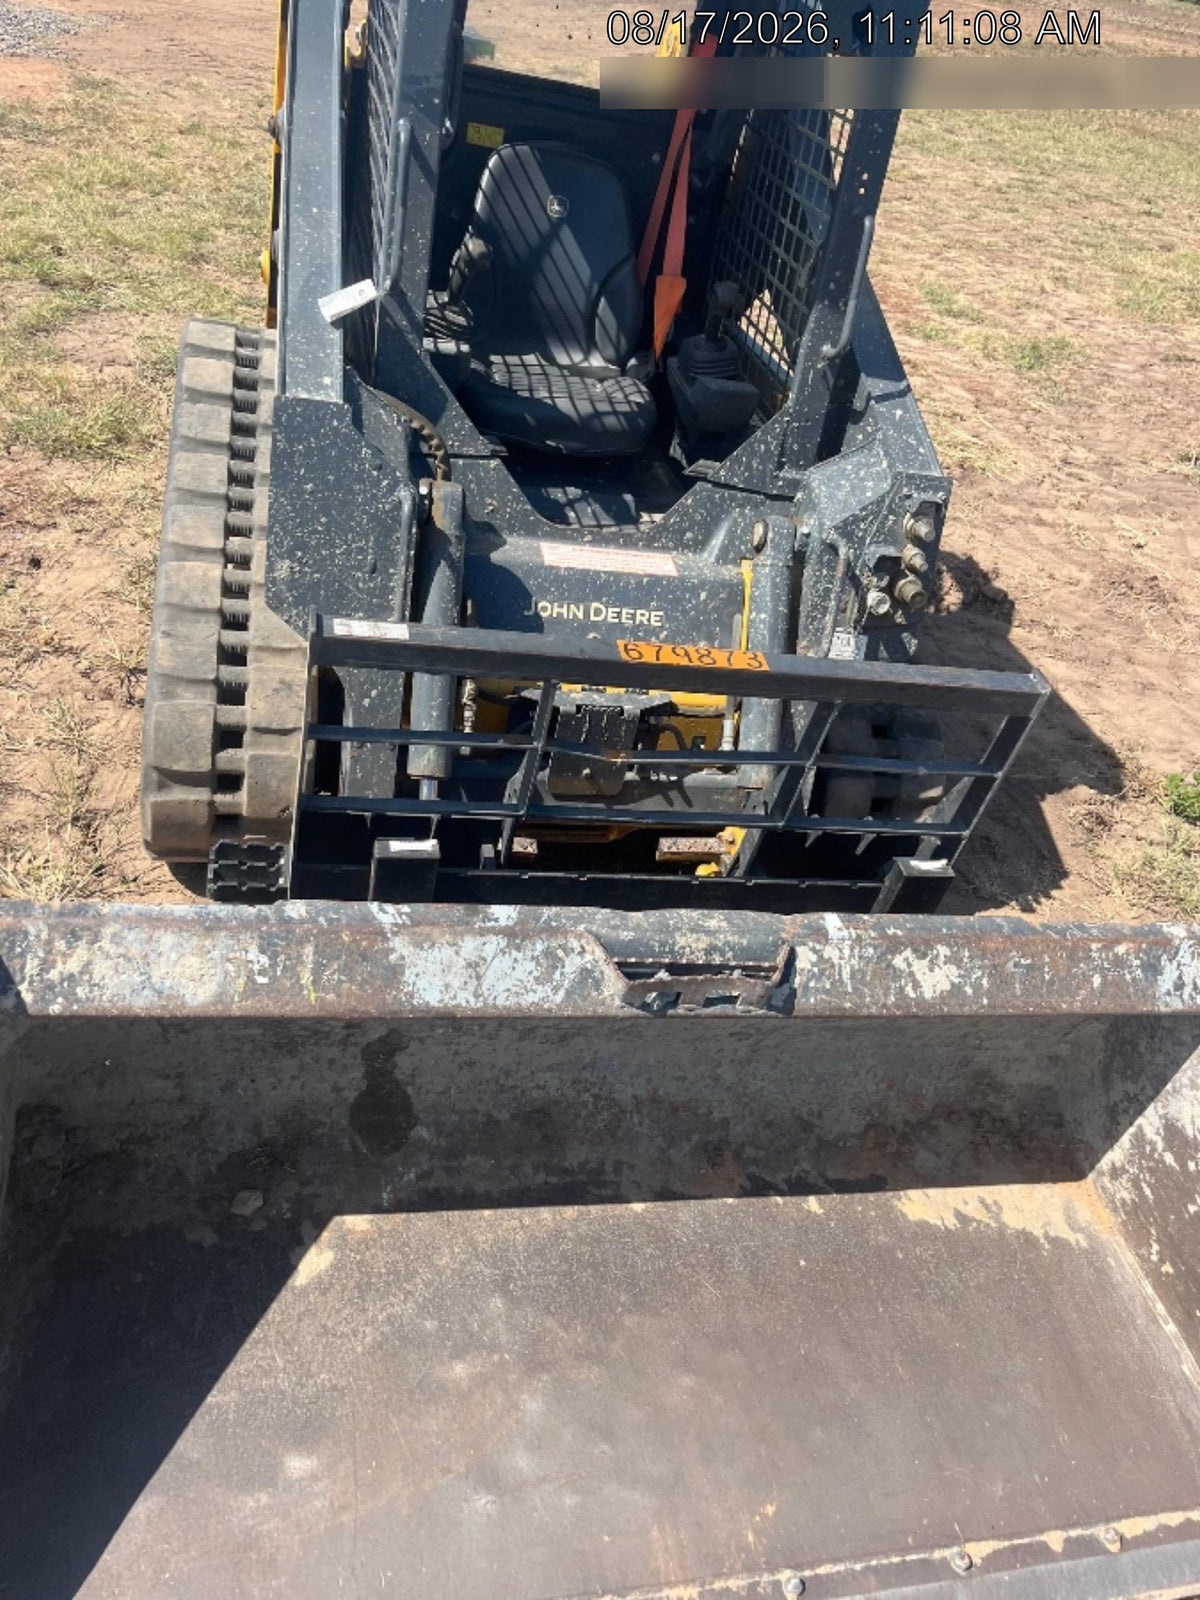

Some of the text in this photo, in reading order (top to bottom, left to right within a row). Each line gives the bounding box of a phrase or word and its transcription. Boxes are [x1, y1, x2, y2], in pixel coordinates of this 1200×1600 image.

[524, 596, 664, 627] JOHN DEERE
[623, 642, 764, 669] 679873
